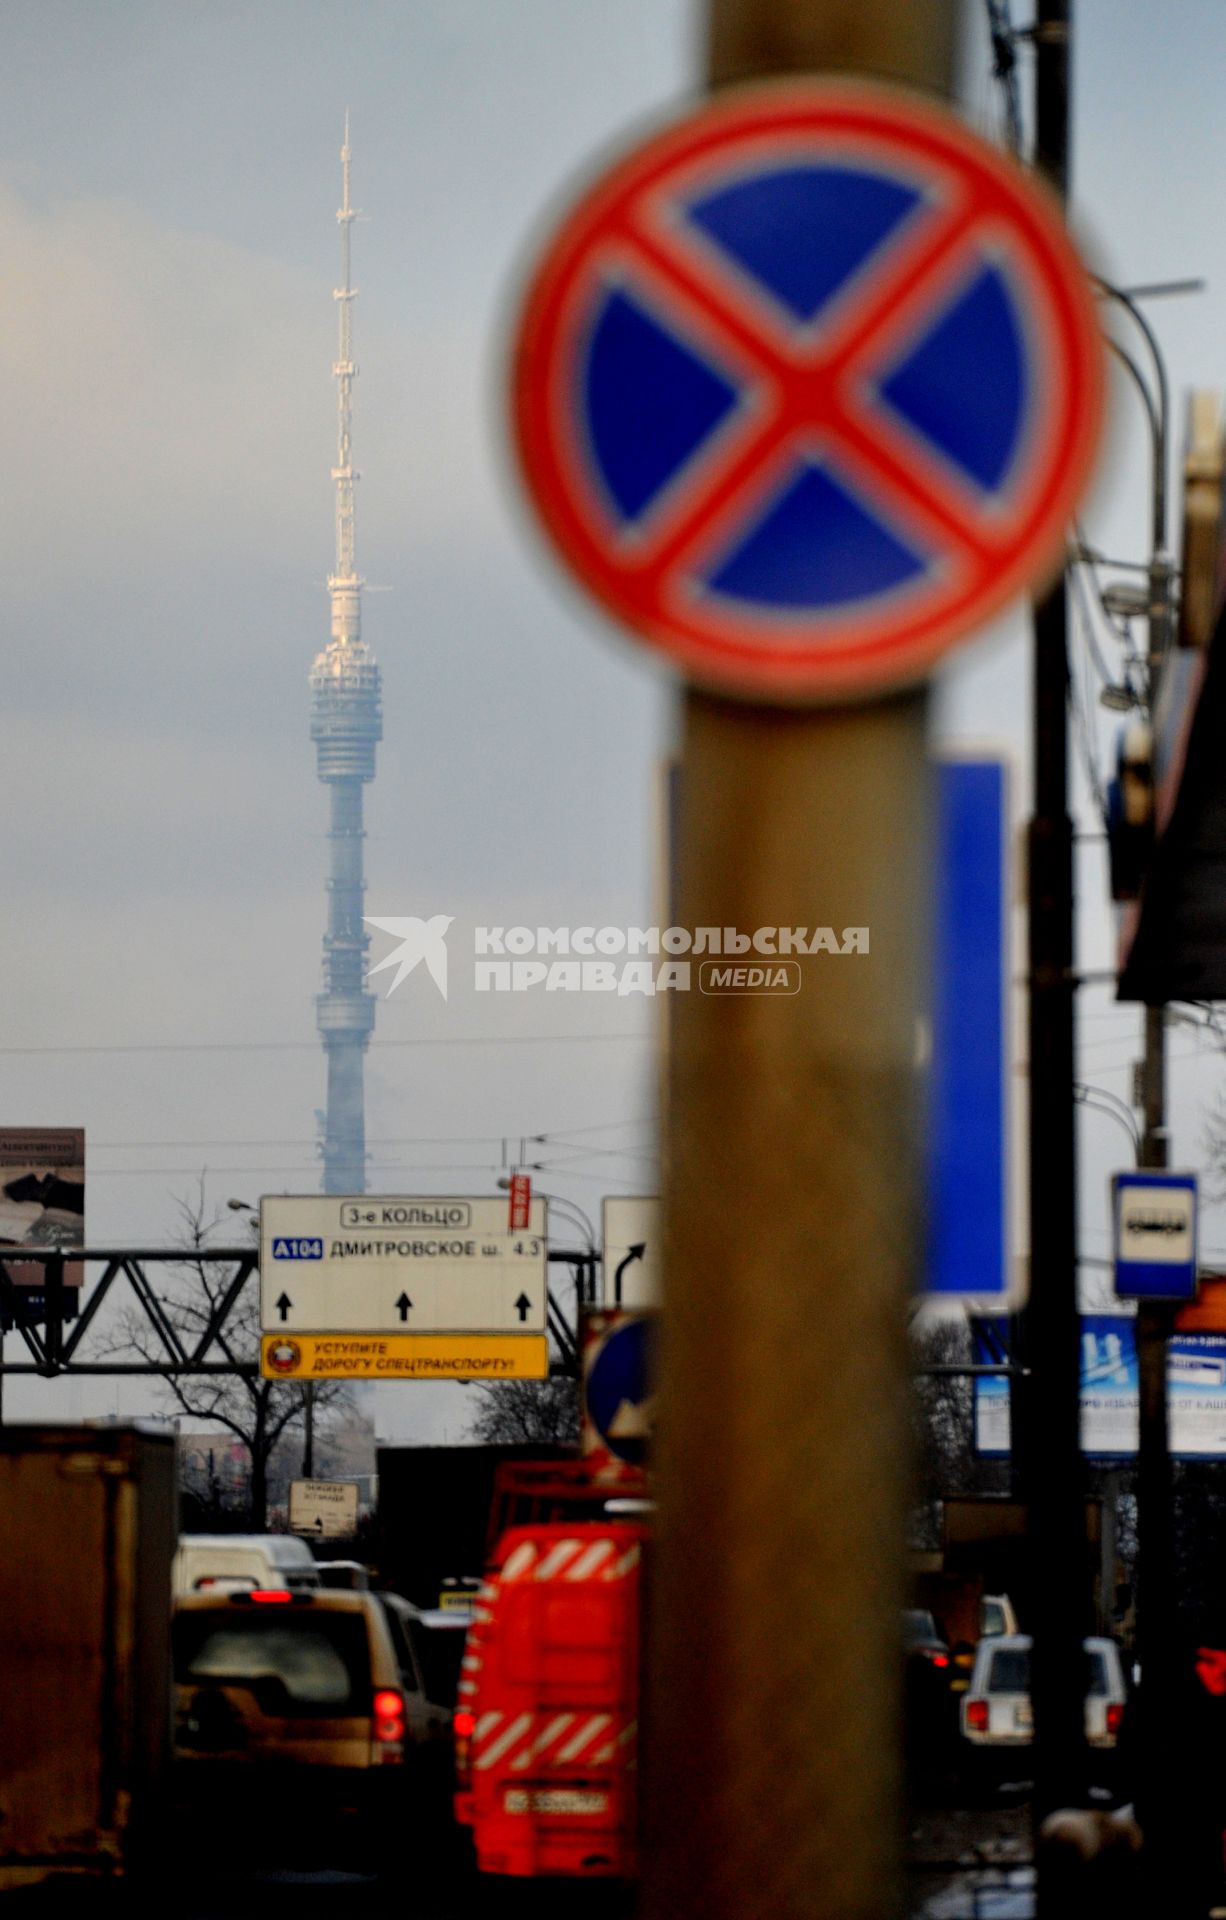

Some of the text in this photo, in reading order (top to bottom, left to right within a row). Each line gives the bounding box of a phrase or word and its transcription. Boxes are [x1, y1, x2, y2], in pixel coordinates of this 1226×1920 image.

[382, 1207, 463, 1225] КОЛЬЦО
[274, 1241, 321, 1258] А104
[330, 1241, 475, 1258] ДМИТРОВСКОЕ
[314, 1342, 389, 1354] УСТУПИТЕ
[312, 1358, 515, 1371] ДОРОГУ СПЕЦТРАНСПОРТУ!
